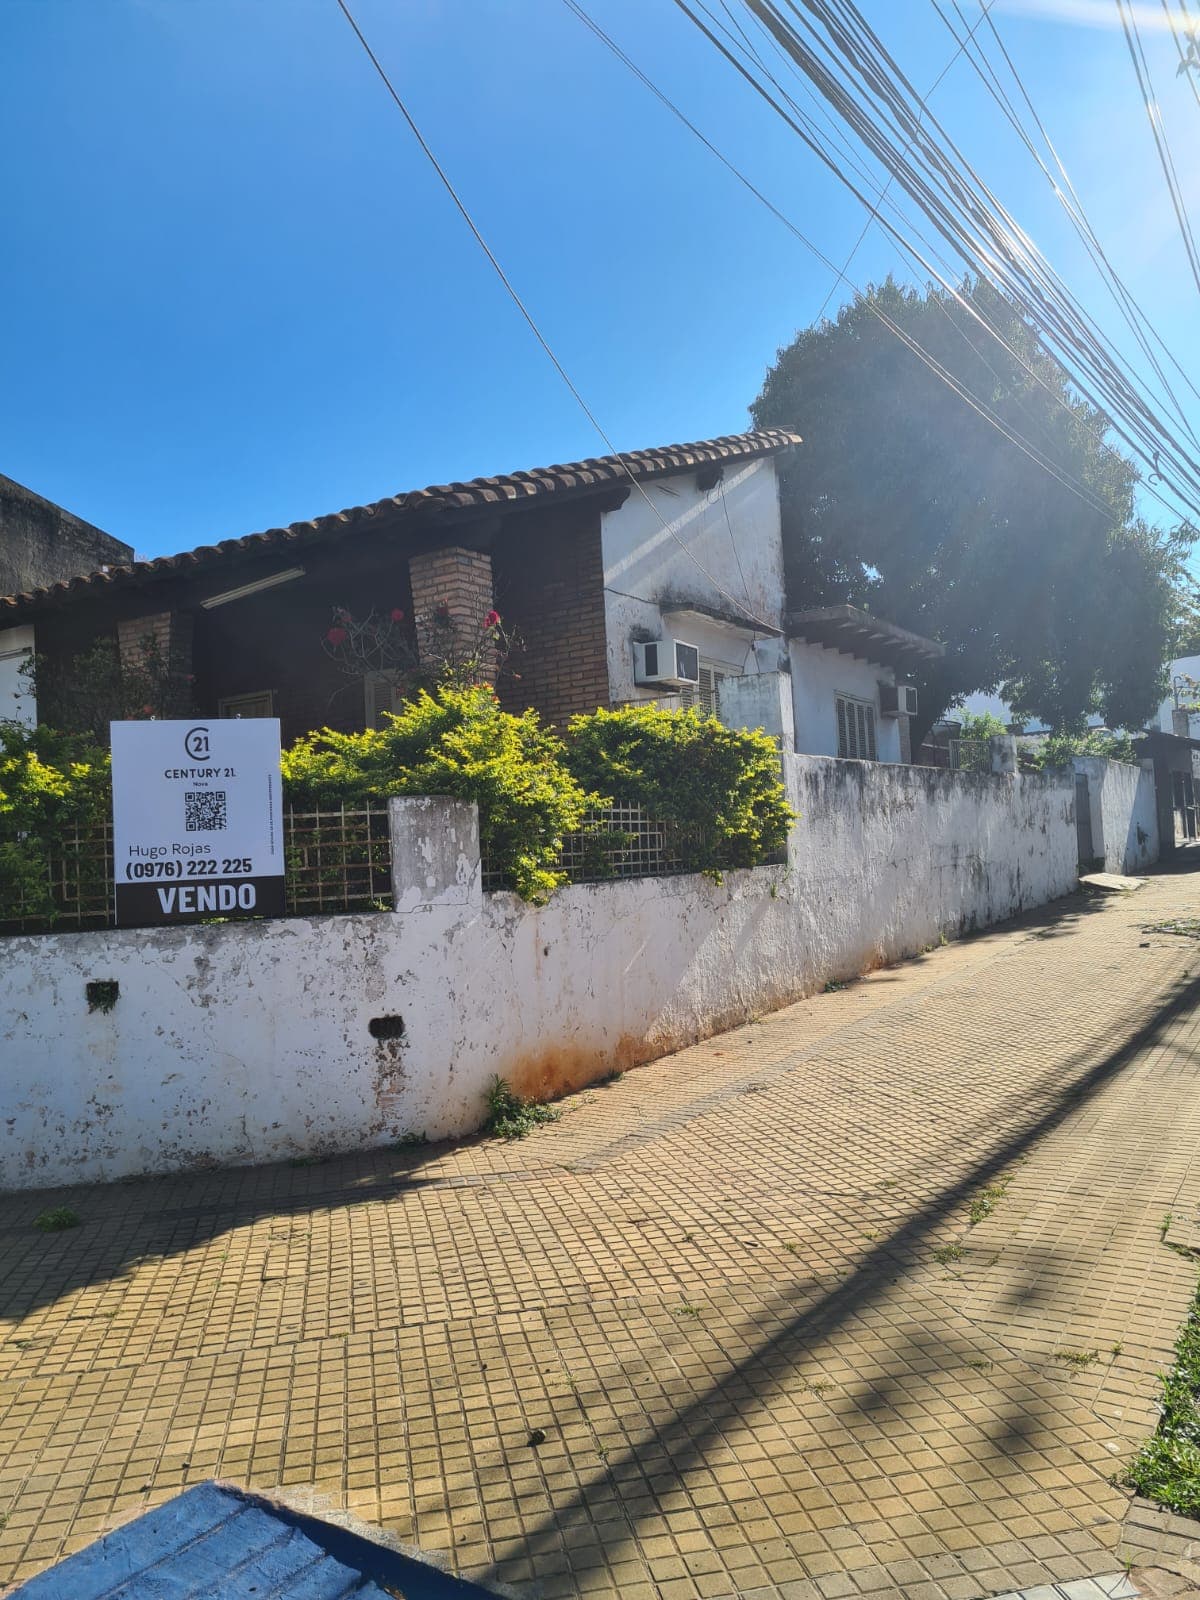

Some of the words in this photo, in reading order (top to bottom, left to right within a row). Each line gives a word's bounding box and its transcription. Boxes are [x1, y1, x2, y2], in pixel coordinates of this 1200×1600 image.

[164, 768, 221, 779] CENTURY
[129, 845, 167, 859] Hugo
[172, 843, 211, 857] Rojas
[126, 860, 182, 880] (0976)
[187, 860, 217, 875] 222
[222, 858, 252, 873] 225
[157, 883, 256, 914] VENDO
